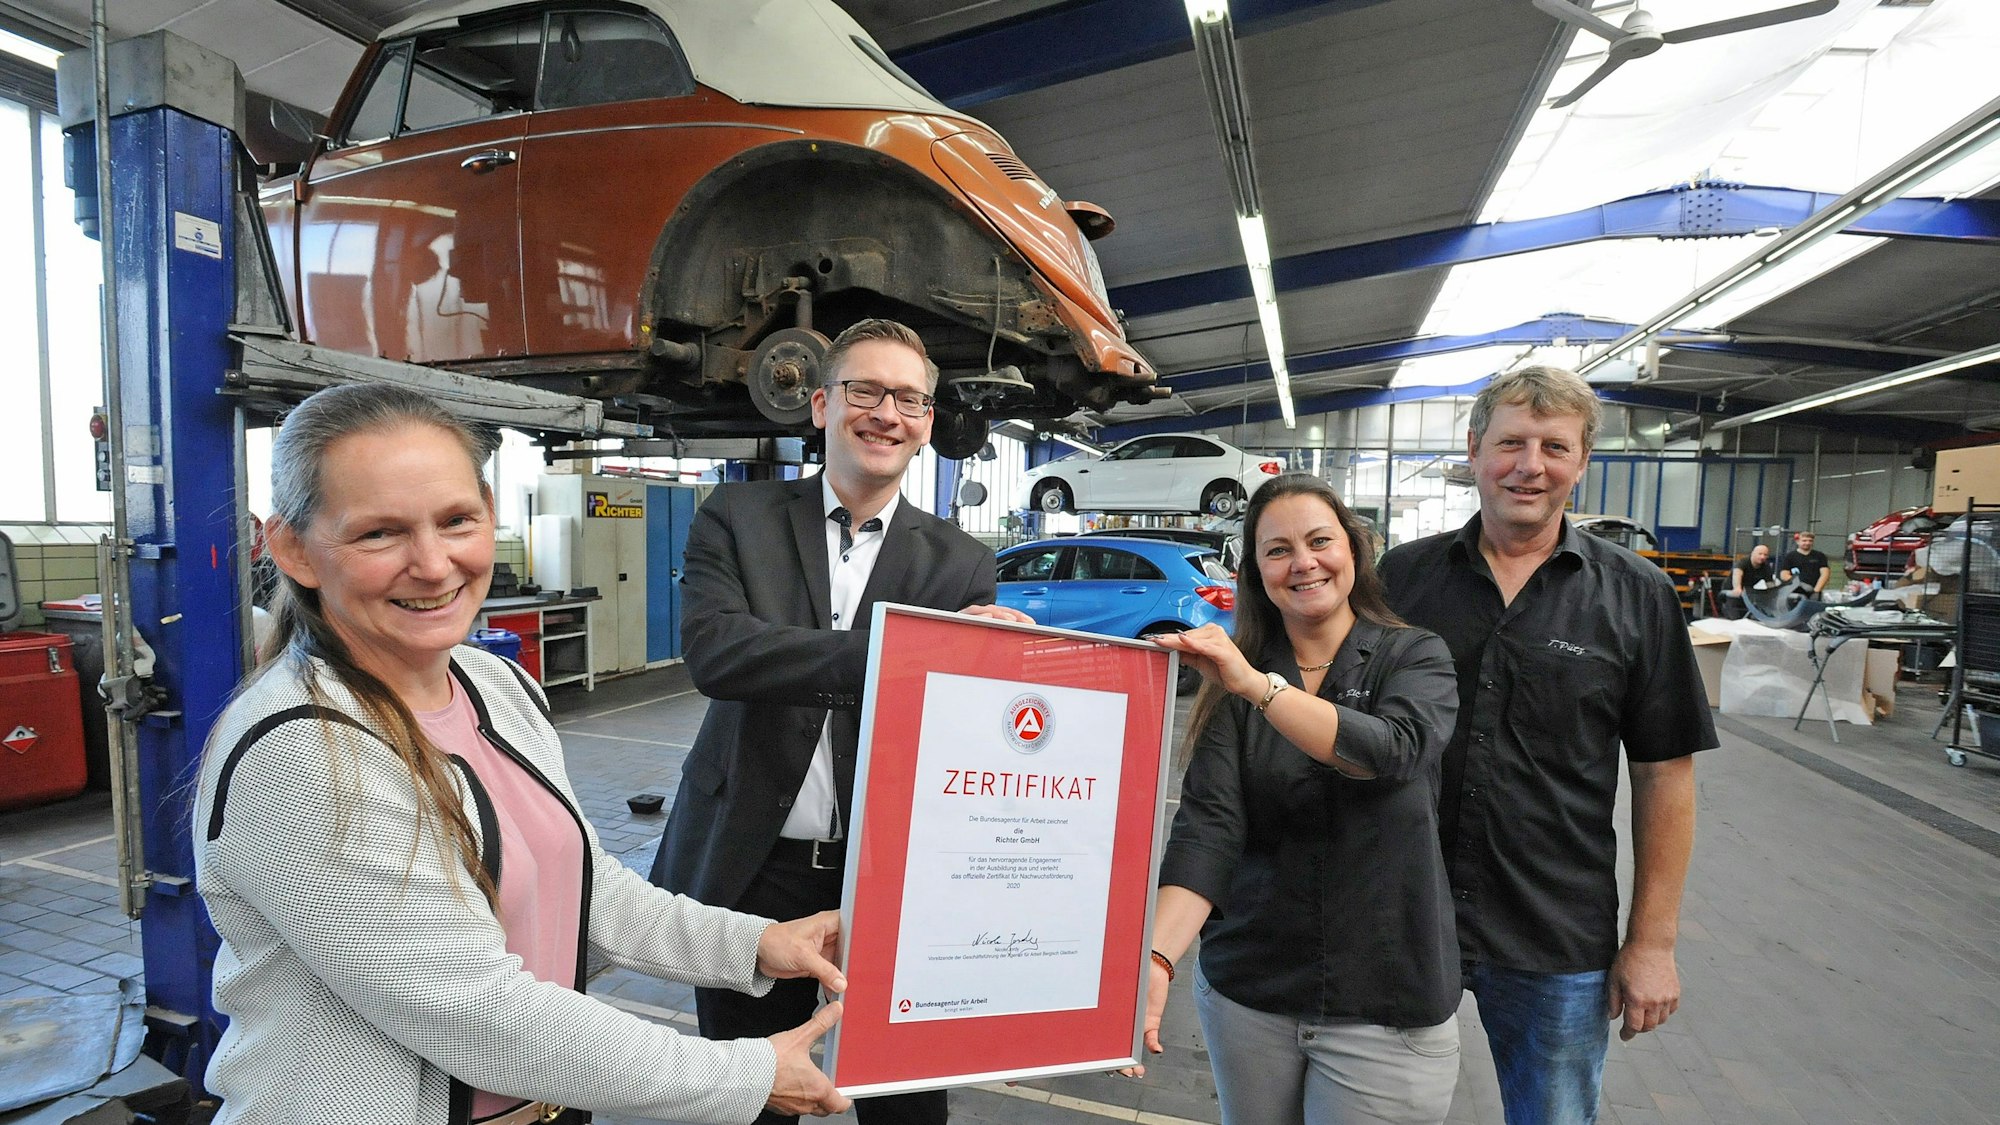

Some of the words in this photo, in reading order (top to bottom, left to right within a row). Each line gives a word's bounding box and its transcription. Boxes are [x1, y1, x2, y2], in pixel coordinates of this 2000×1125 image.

[595, 495, 642, 517] RICHTER
[1010, 698, 1050, 718] AUSGEZEICHNETE
[943, 769, 1097, 800] ZERTIFIKAT
[980, 816, 1021, 824] Bundesagentur
[995, 836, 1019, 844] Richter
[988, 857, 1028, 865] hervorragende
[1028, 857, 1062, 865] Engagement
[986, 865, 1017, 873] Ausbildung
[962, 873, 986, 881] offizielle
[1020, 873, 1074, 881] Nachwuchsförderung
[915, 1000, 960, 1008] Bundesagentur
